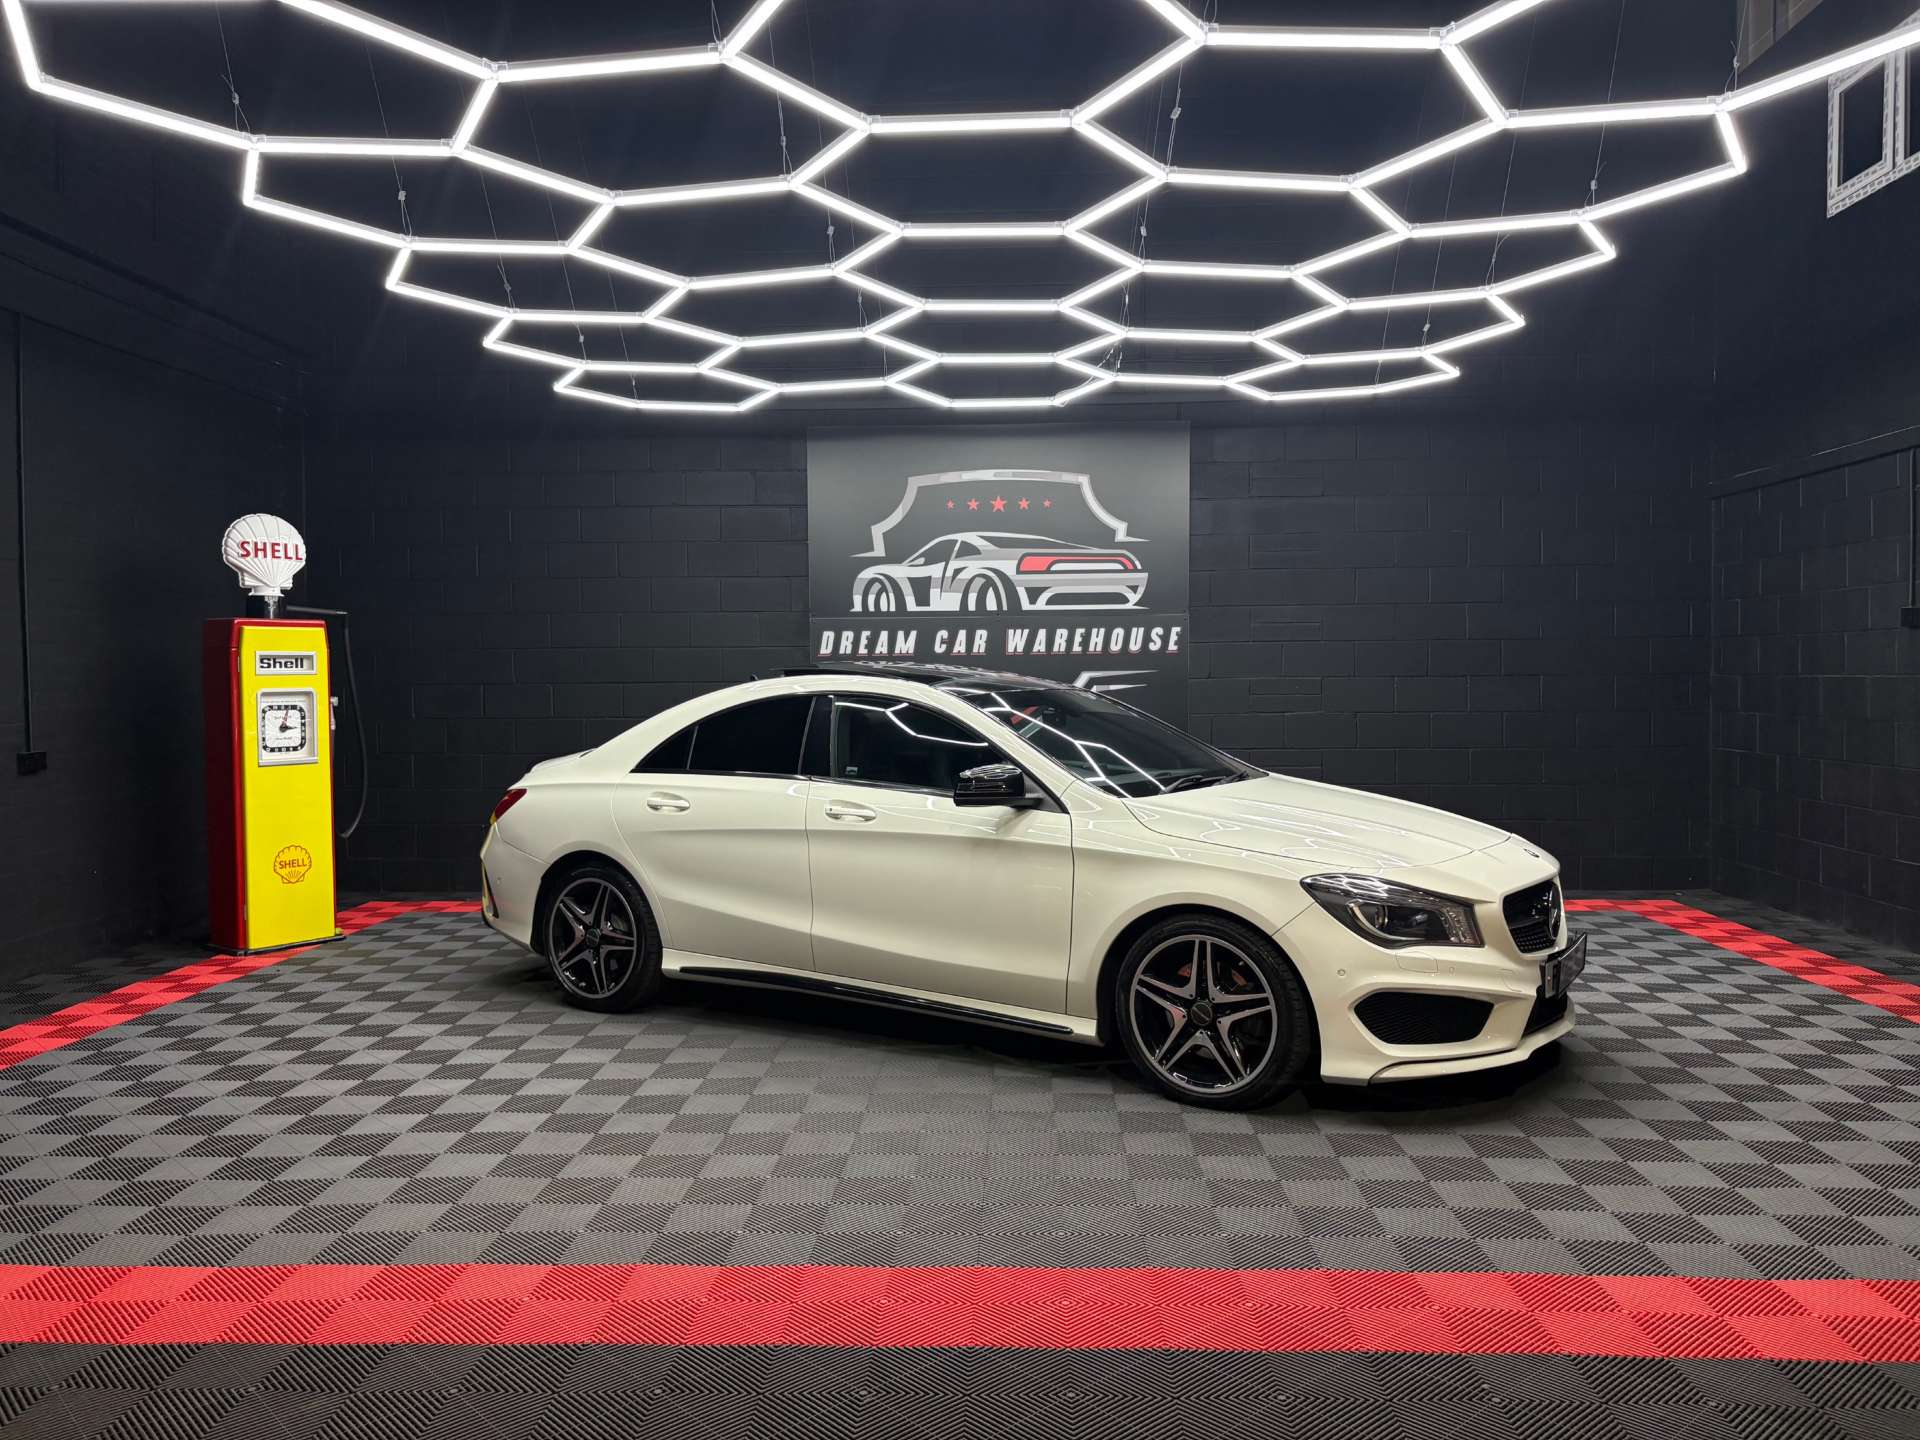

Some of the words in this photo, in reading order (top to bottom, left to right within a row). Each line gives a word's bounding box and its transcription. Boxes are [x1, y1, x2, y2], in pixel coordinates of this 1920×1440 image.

[240, 541, 303, 561] SHELL
[818, 630, 917, 656] DREAM
[934, 629, 988, 655] CAR
[1006, 626, 1182, 655] WAREHOUSE
[259, 657, 304, 669] Shell
[279, 857, 308, 870] SHELL
